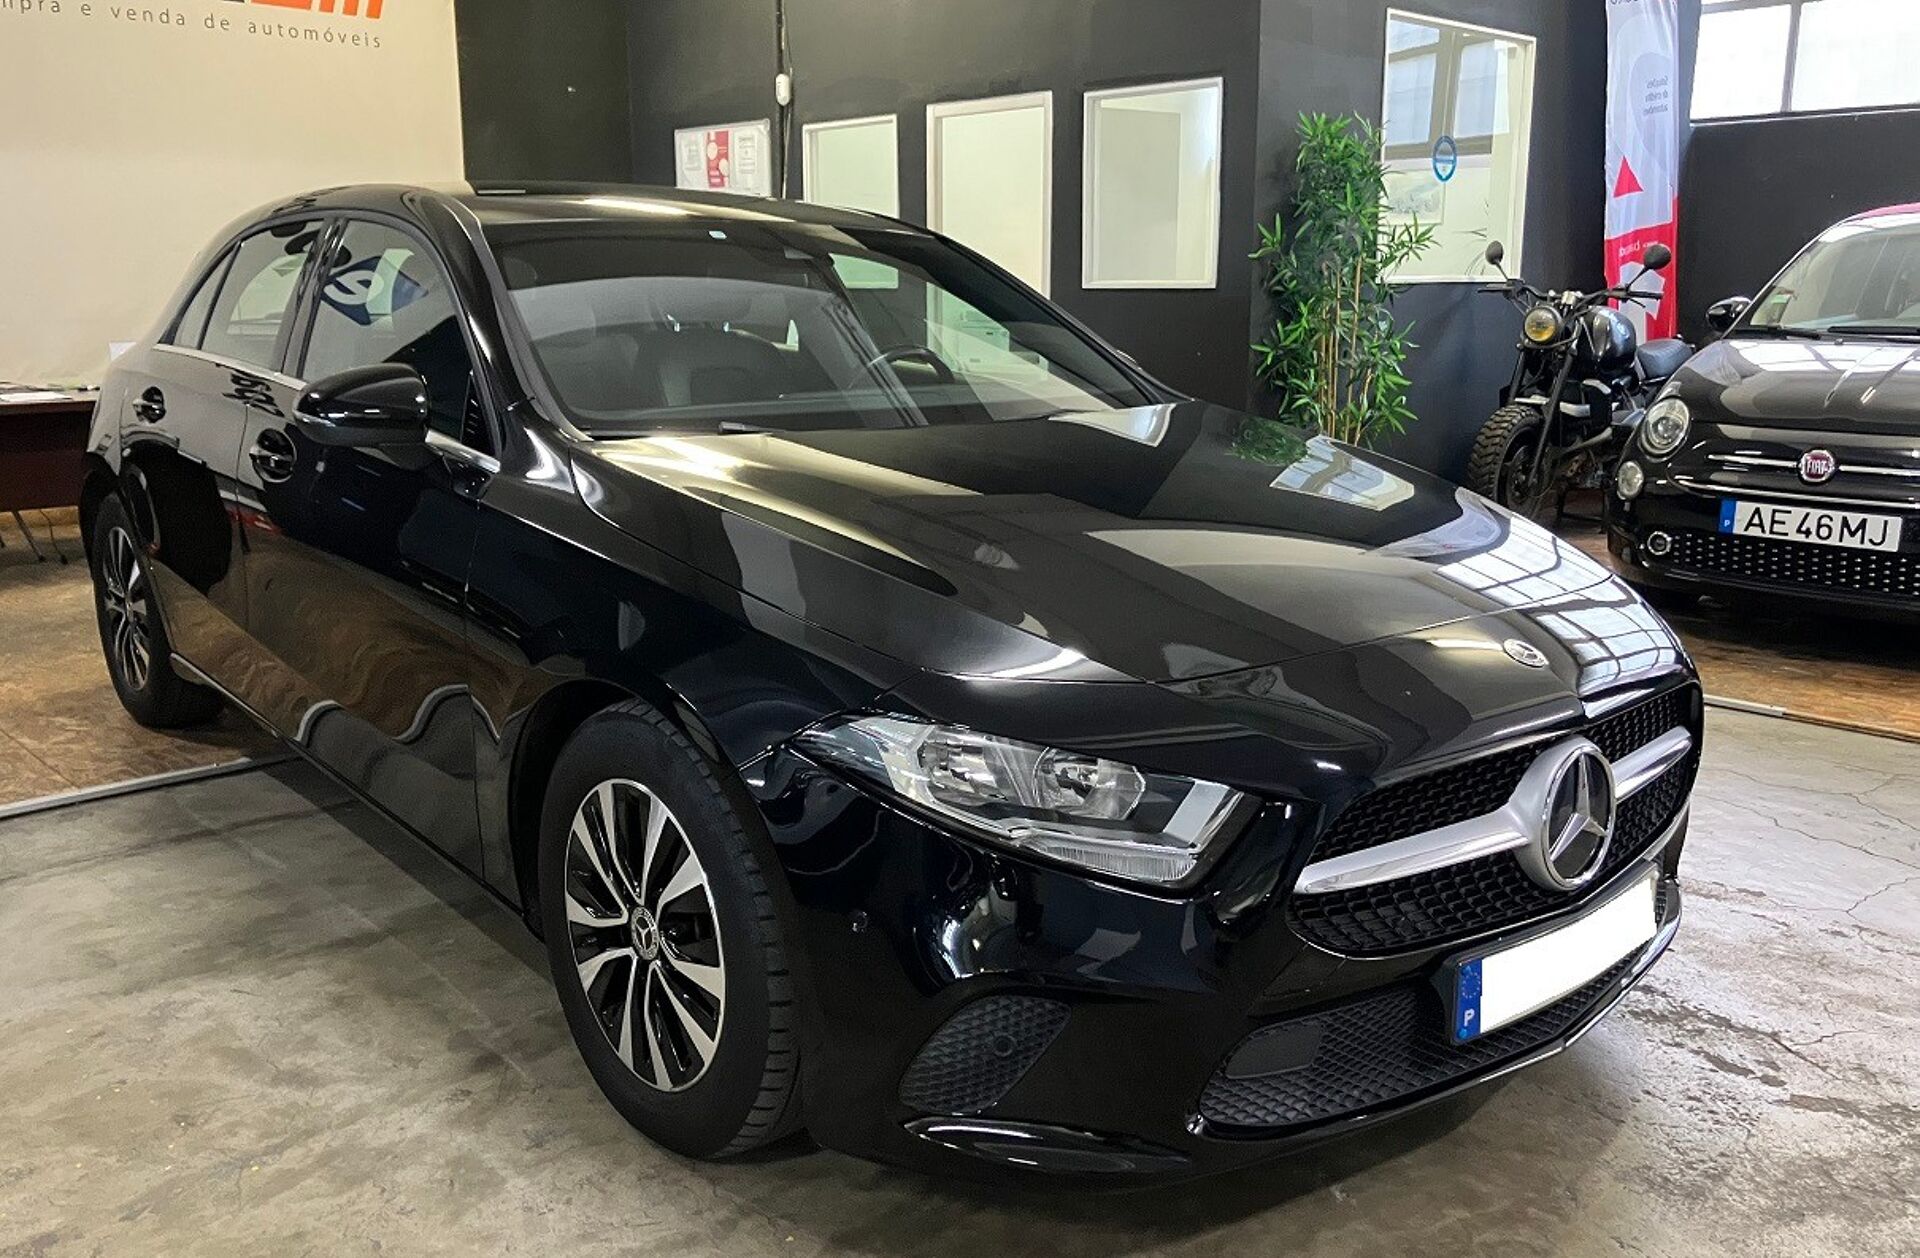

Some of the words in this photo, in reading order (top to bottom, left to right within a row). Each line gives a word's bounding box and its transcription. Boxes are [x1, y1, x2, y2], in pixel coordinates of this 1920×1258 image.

[80, 3, 92, 16] e
[110, 6, 186, 26] venda
[203, 13, 231, 31] de
[248, 19, 382, 48] automóveis
[1807, 459, 1828, 475] FIAT
[1463, 1008, 1475, 1027] P
